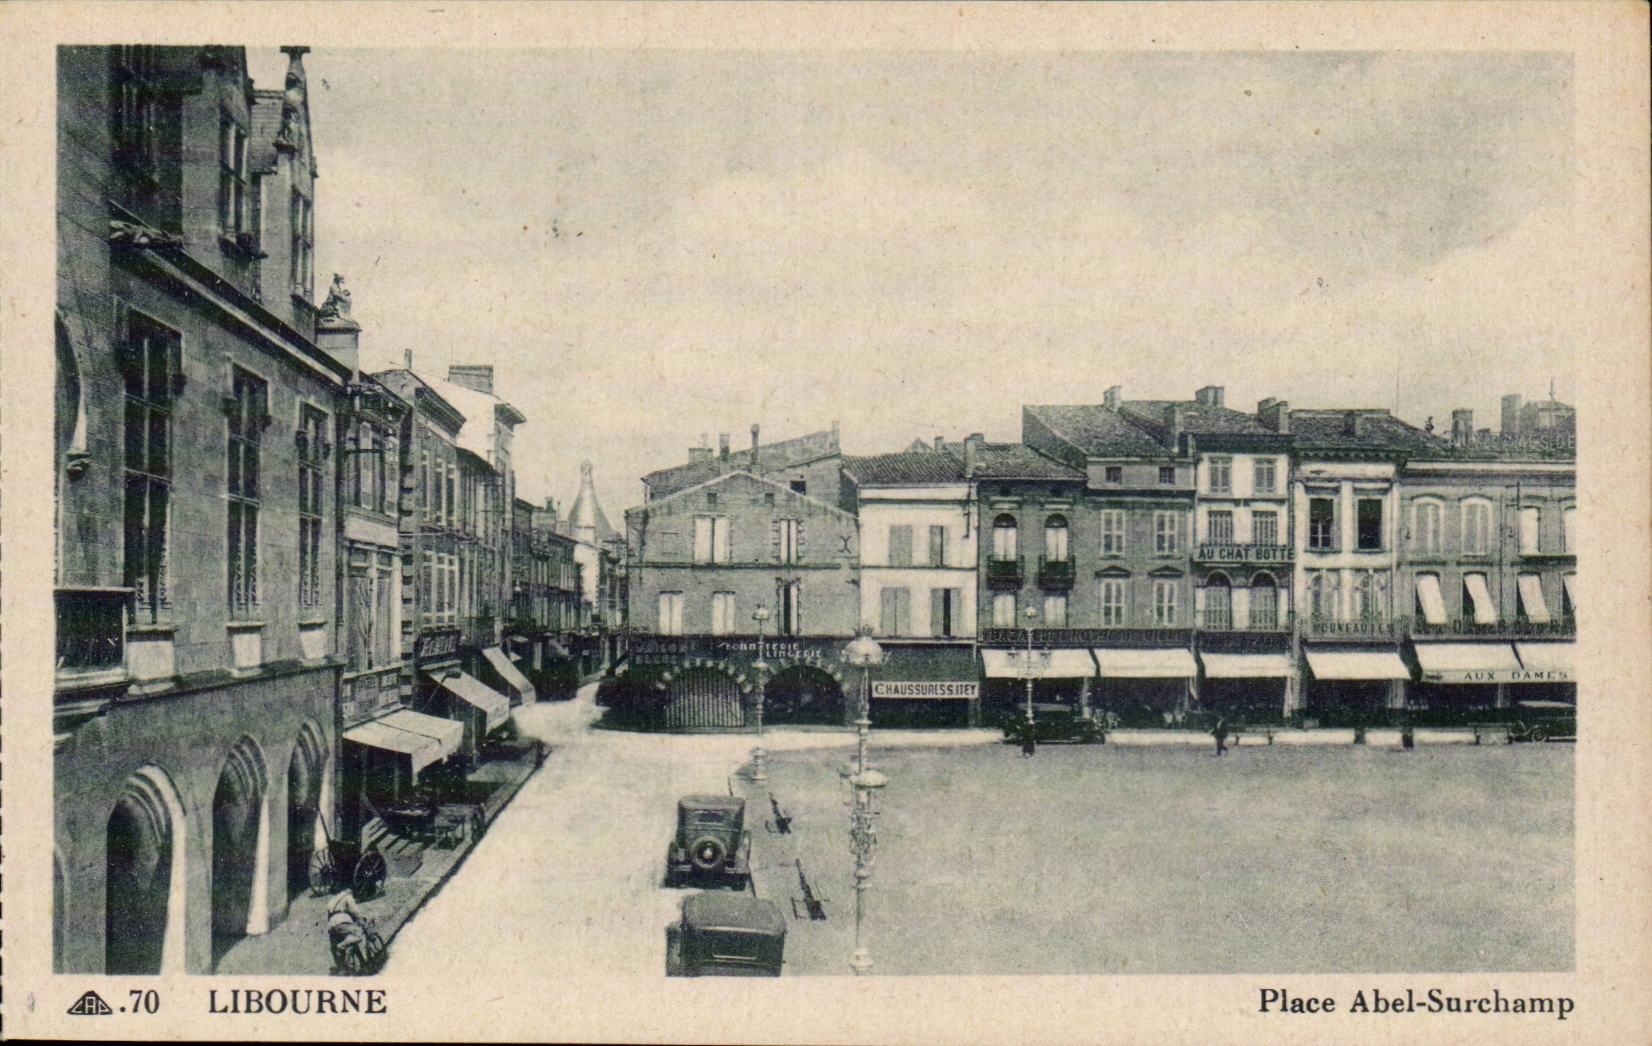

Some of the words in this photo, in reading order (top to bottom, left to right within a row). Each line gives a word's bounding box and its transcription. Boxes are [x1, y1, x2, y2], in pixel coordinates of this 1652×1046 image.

[1198, 548, 1214, 560] AU
[1218, 548, 1250, 560] CHAT
[718, 642, 799, 651] BONNTERIE
[1464, 671, 1495, 680] AUX
[1511, 671, 1568, 680] DAMES
[874, 683, 946, 696] CHAUSSURES
